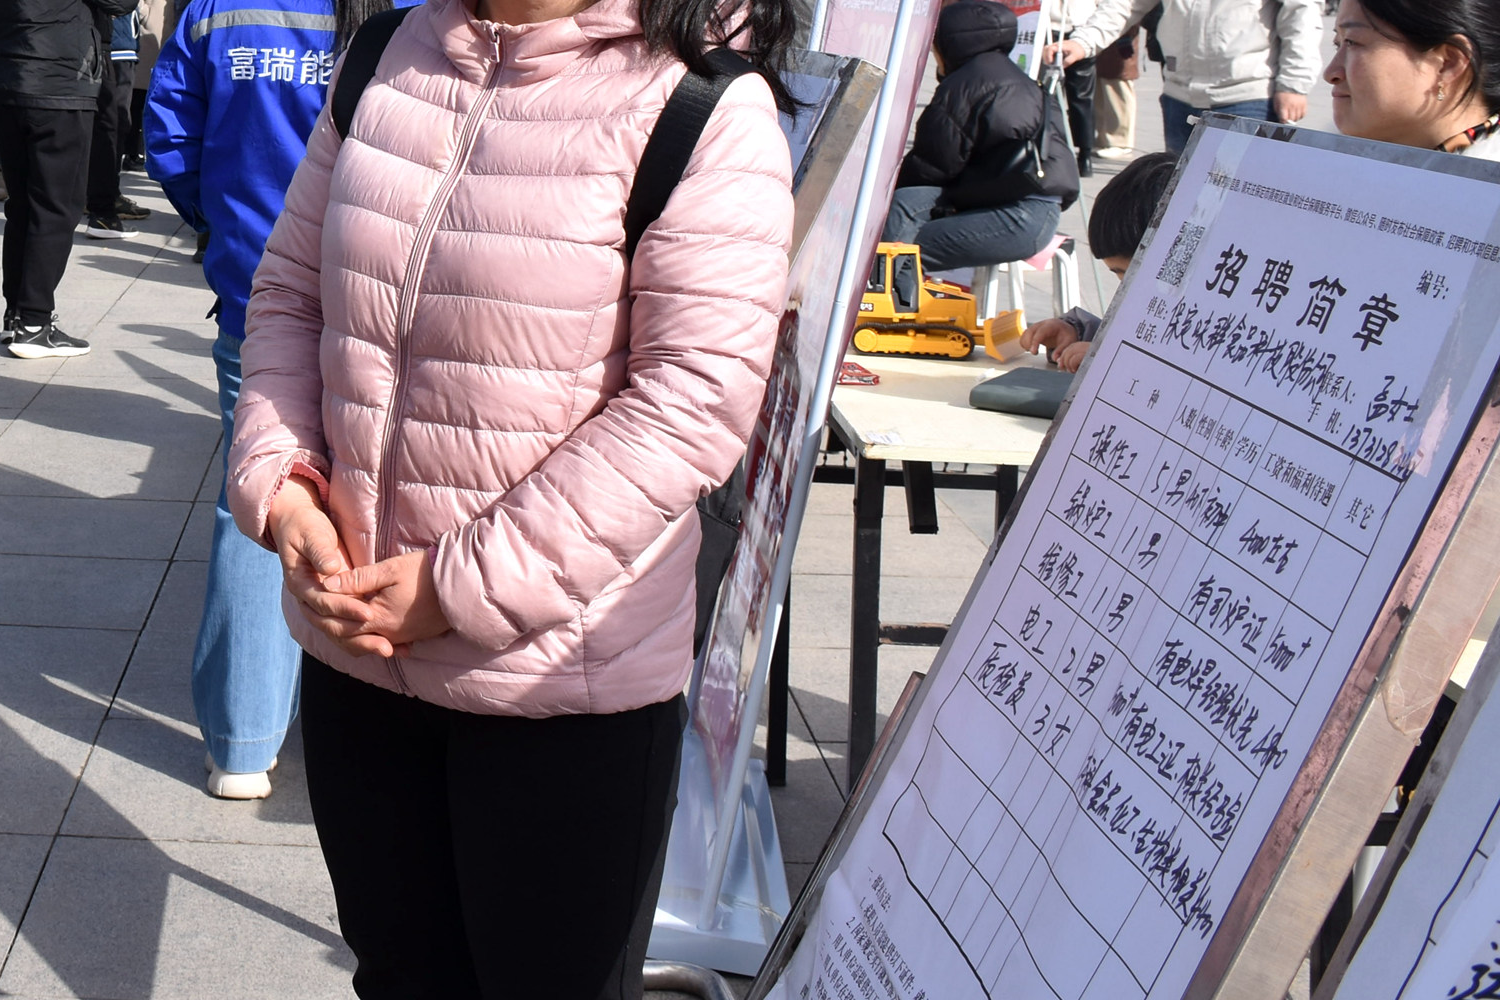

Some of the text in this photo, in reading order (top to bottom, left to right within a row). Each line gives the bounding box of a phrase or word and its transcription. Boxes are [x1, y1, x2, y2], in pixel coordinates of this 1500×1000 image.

[228, 46, 335, 86] 富瑞能
[1206, 243, 1400, 351] 招聘简章
[1175, 405, 1197, 430] 人数
[1195, 413, 1217, 440] 性别
[1214, 424, 1235, 451] 年龄
[1235, 436, 1262, 464] 学历
[1261, 451, 1336, 507] 工资和福利待遇
[1344, 497, 1374, 530] 其它
[1019, 603, 1053, 655] 电工
